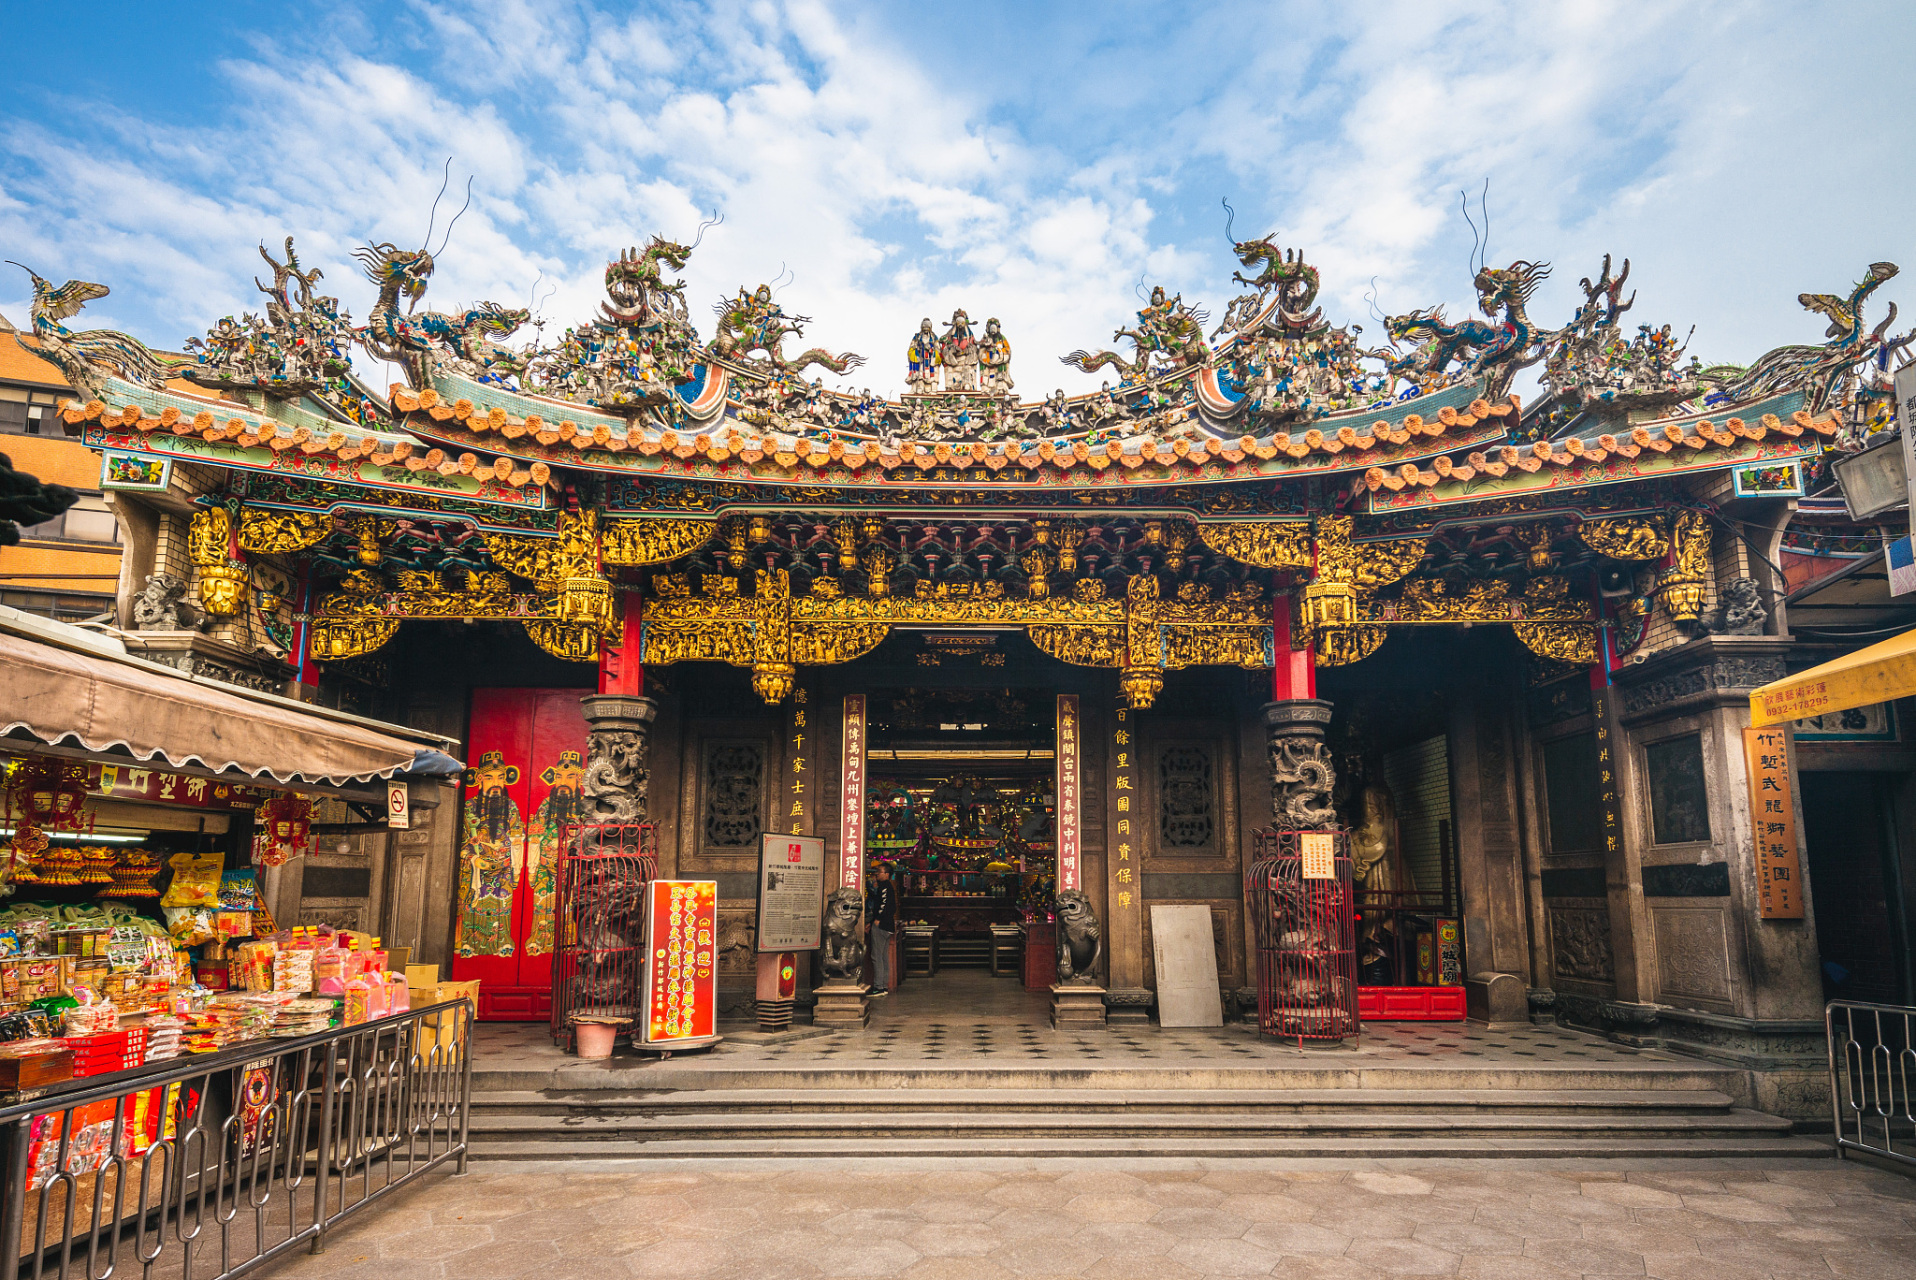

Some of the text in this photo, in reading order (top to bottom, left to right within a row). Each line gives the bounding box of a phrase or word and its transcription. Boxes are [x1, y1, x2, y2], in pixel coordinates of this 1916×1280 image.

[1766, 695, 1829, 717] 0932-178295
[1114, 690, 1133, 909] 百餘里版圖同資保障
[1757, 733, 1790, 882] 竹塹武龍獅藝團
[697, 929, 711, 966] 歡迎
